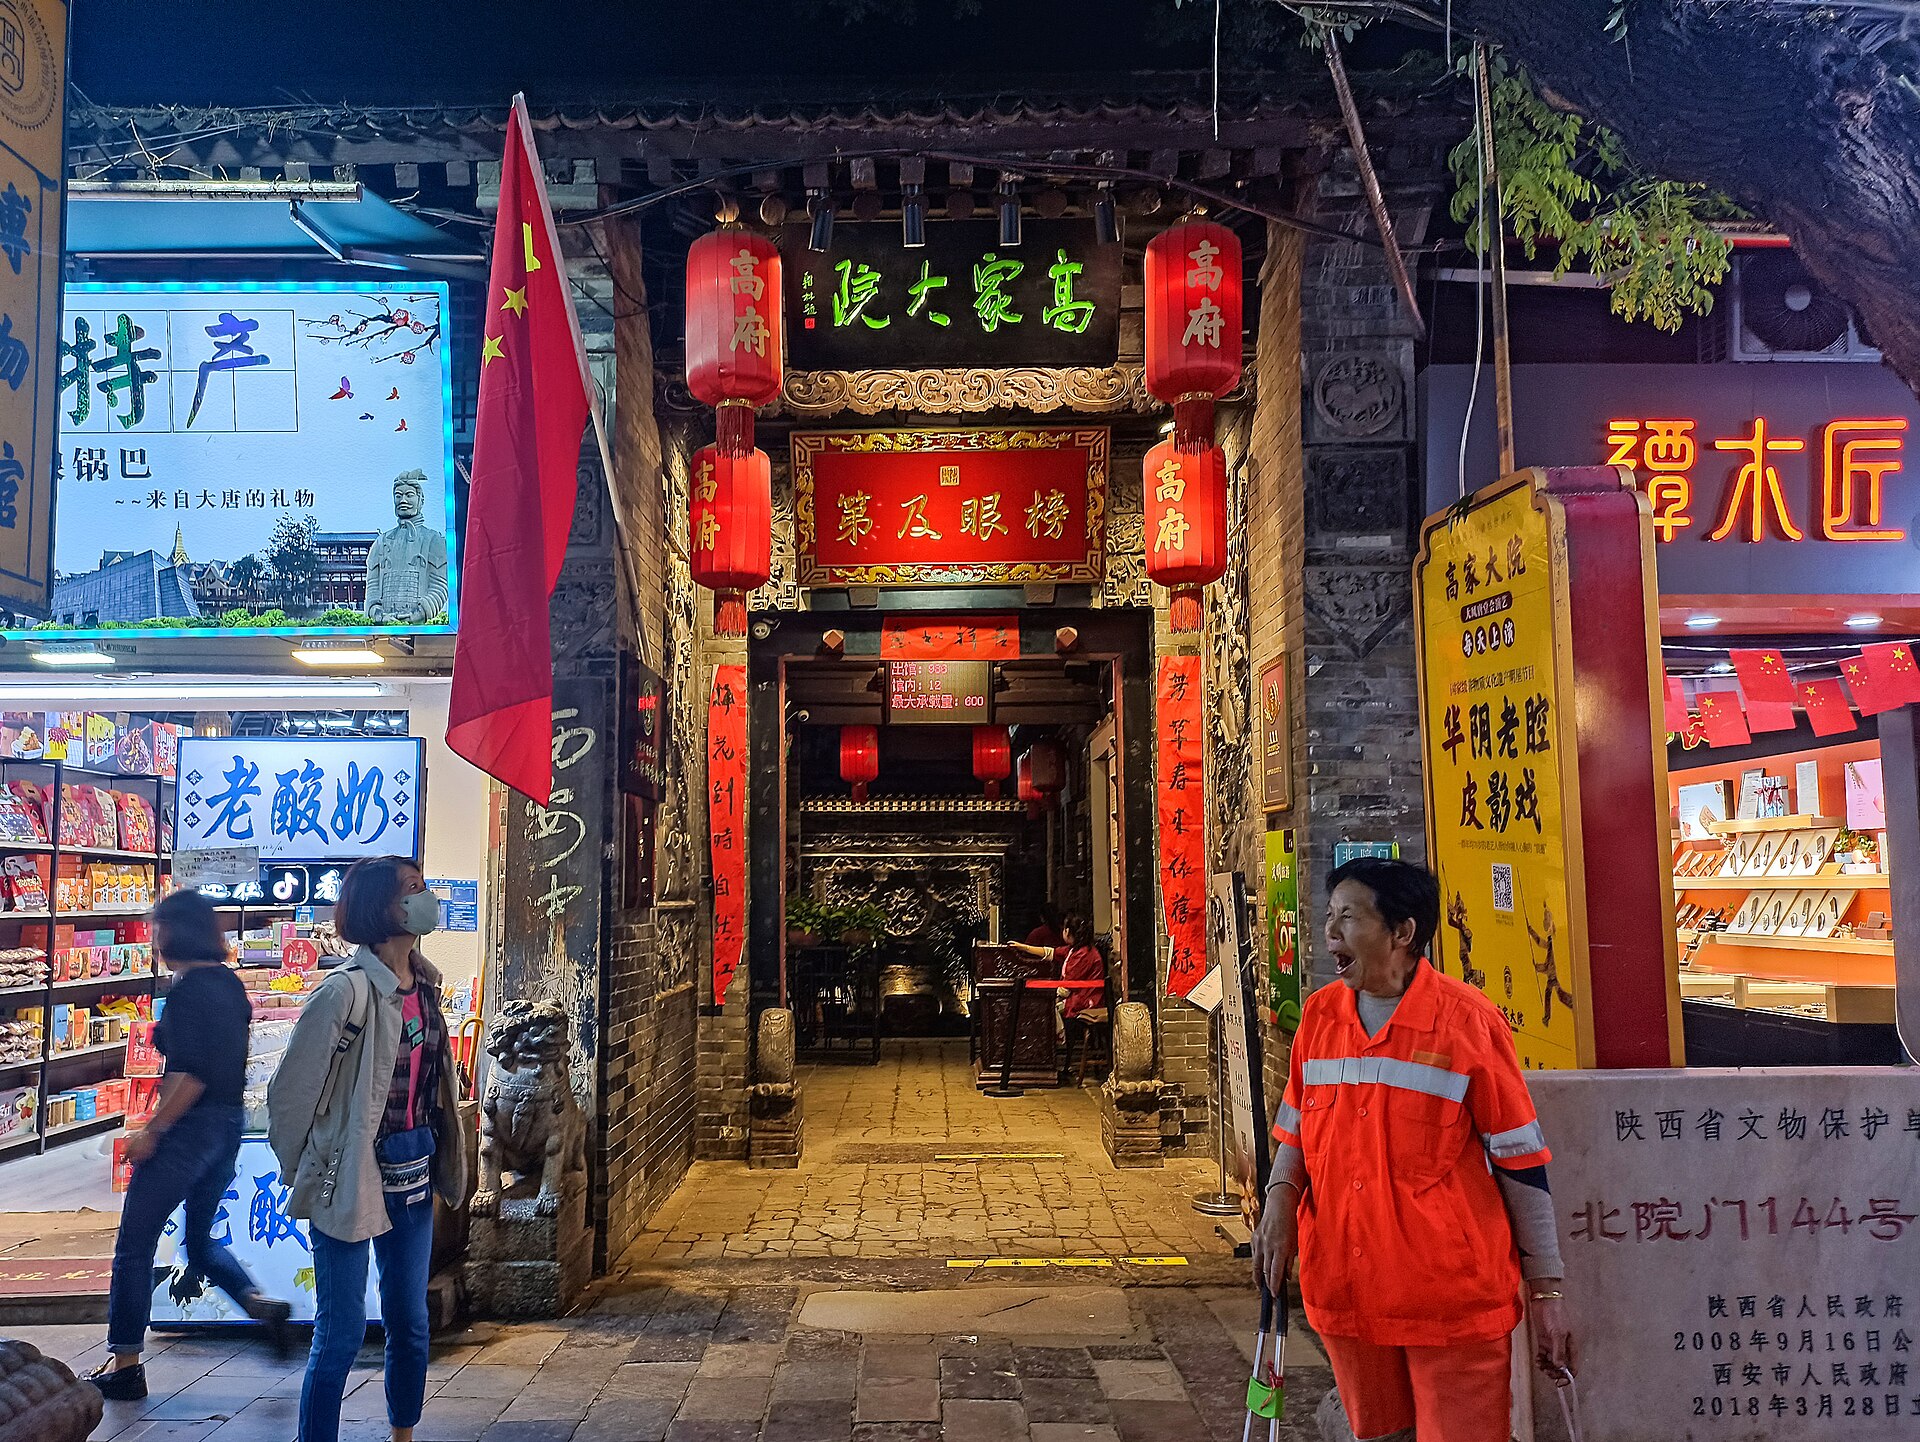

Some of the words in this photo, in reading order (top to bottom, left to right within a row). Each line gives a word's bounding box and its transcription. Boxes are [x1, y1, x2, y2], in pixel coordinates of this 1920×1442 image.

[729, 248, 772, 358] 高府
[831, 247, 1097, 335] 高家大院
[1180, 239, 1227, 350] 高府
[60, 312, 271, 430] 特产
[56, 446, 153, 483] 锅巴
[691, 459, 721, 554] 高府
[834, 489, 1071, 548] 榜眼及第
[1153, 459, 1191, 554] 高府
[1444, 533, 1527, 603] 高家大院
[1462, 620, 1515, 658] 每天上演
[929, 680, 942, 691] 12
[964, 695, 984, 707] 600
[1440, 692, 1551, 767] 华阴老腔
[200, 754, 391, 845] 老酸奶
[1459, 766, 1543, 835] 皮影戏
[1496, 1005, 1525, 1027] 家大院
[1568, 1195, 1919, 1243] 北院门144号
[1707, 1293, 1905, 1320] 陕西省人民政府
[1673, 1330, 1913, 1355] 2008年9月16日公
[1713, 1362, 1909, 1387] 西安市人民政府
